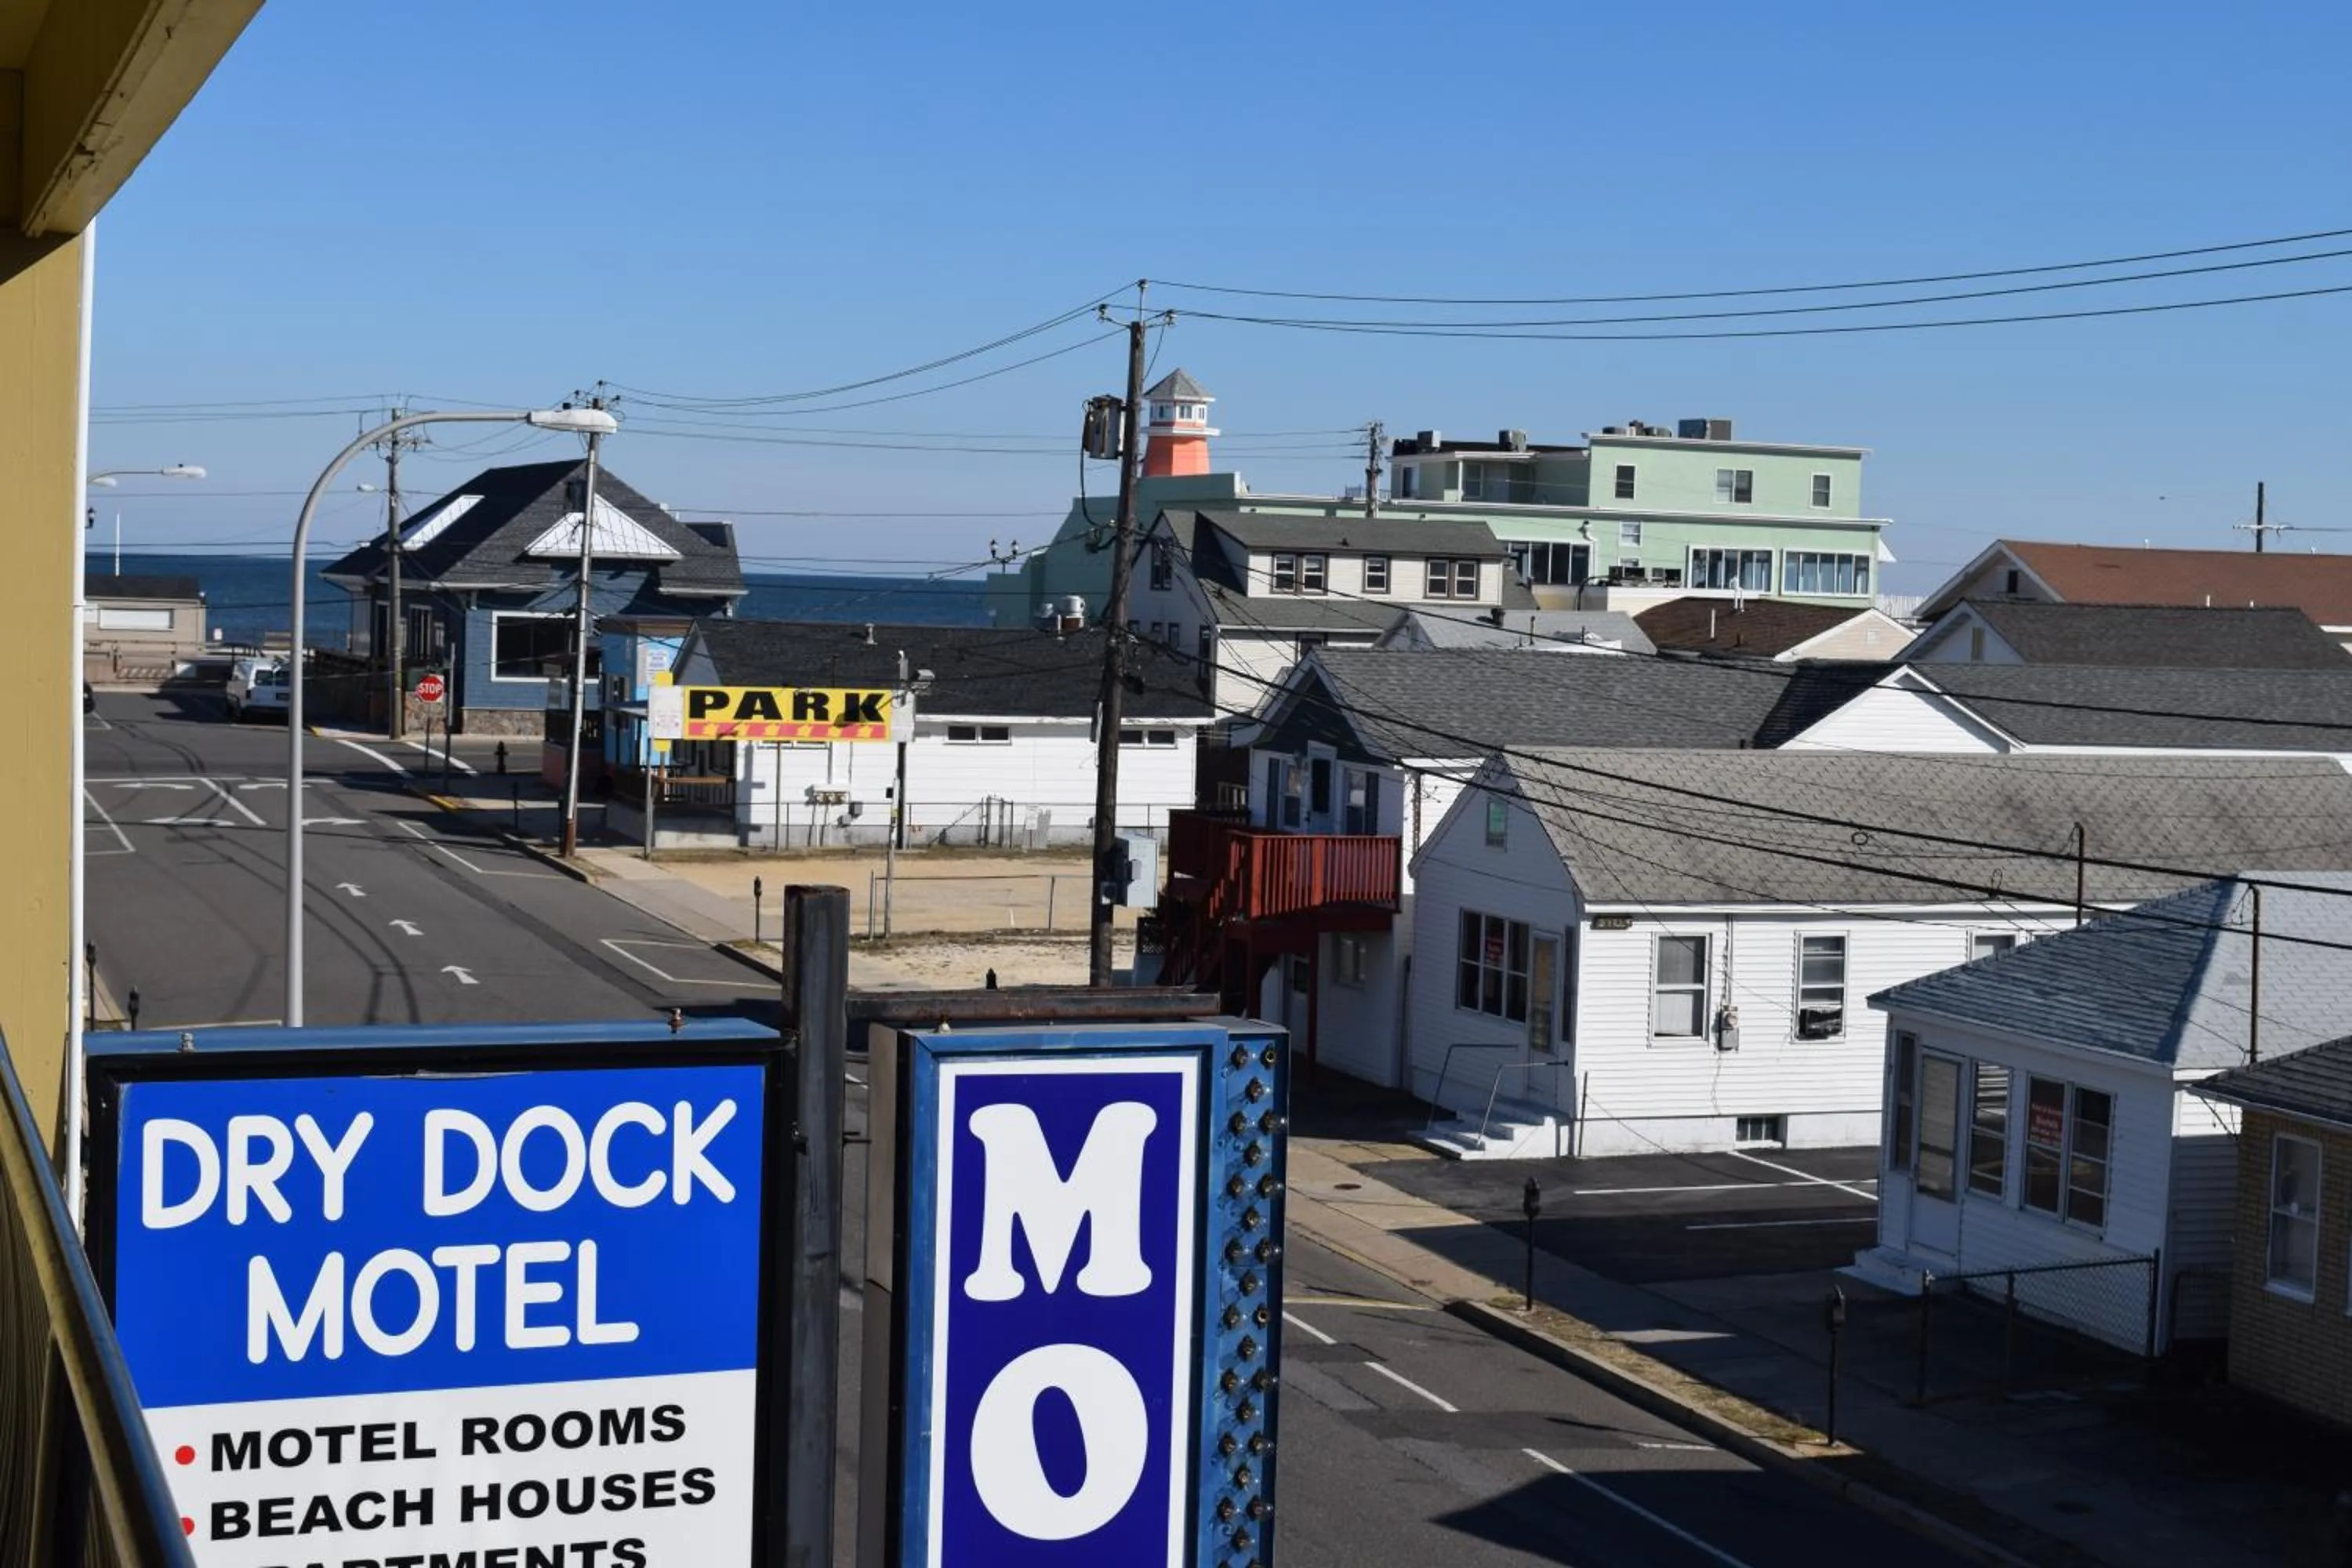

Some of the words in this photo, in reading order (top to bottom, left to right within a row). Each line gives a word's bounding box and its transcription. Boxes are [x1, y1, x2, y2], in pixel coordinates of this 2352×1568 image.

[419, 683, 442, 694] STOP
[689, 689, 884, 722] PARK
[142, 1112, 374, 1229] DRY
[423, 1098, 737, 1216] DOCK
[247, 1239, 640, 1364] MOTEL
[211, 1421, 437, 1472] MOTEL
[461, 1404, 686, 1456] ROOMS
[211, 1487, 434, 1541] BEACH
[460, 1467, 716, 1523] HOUSES
